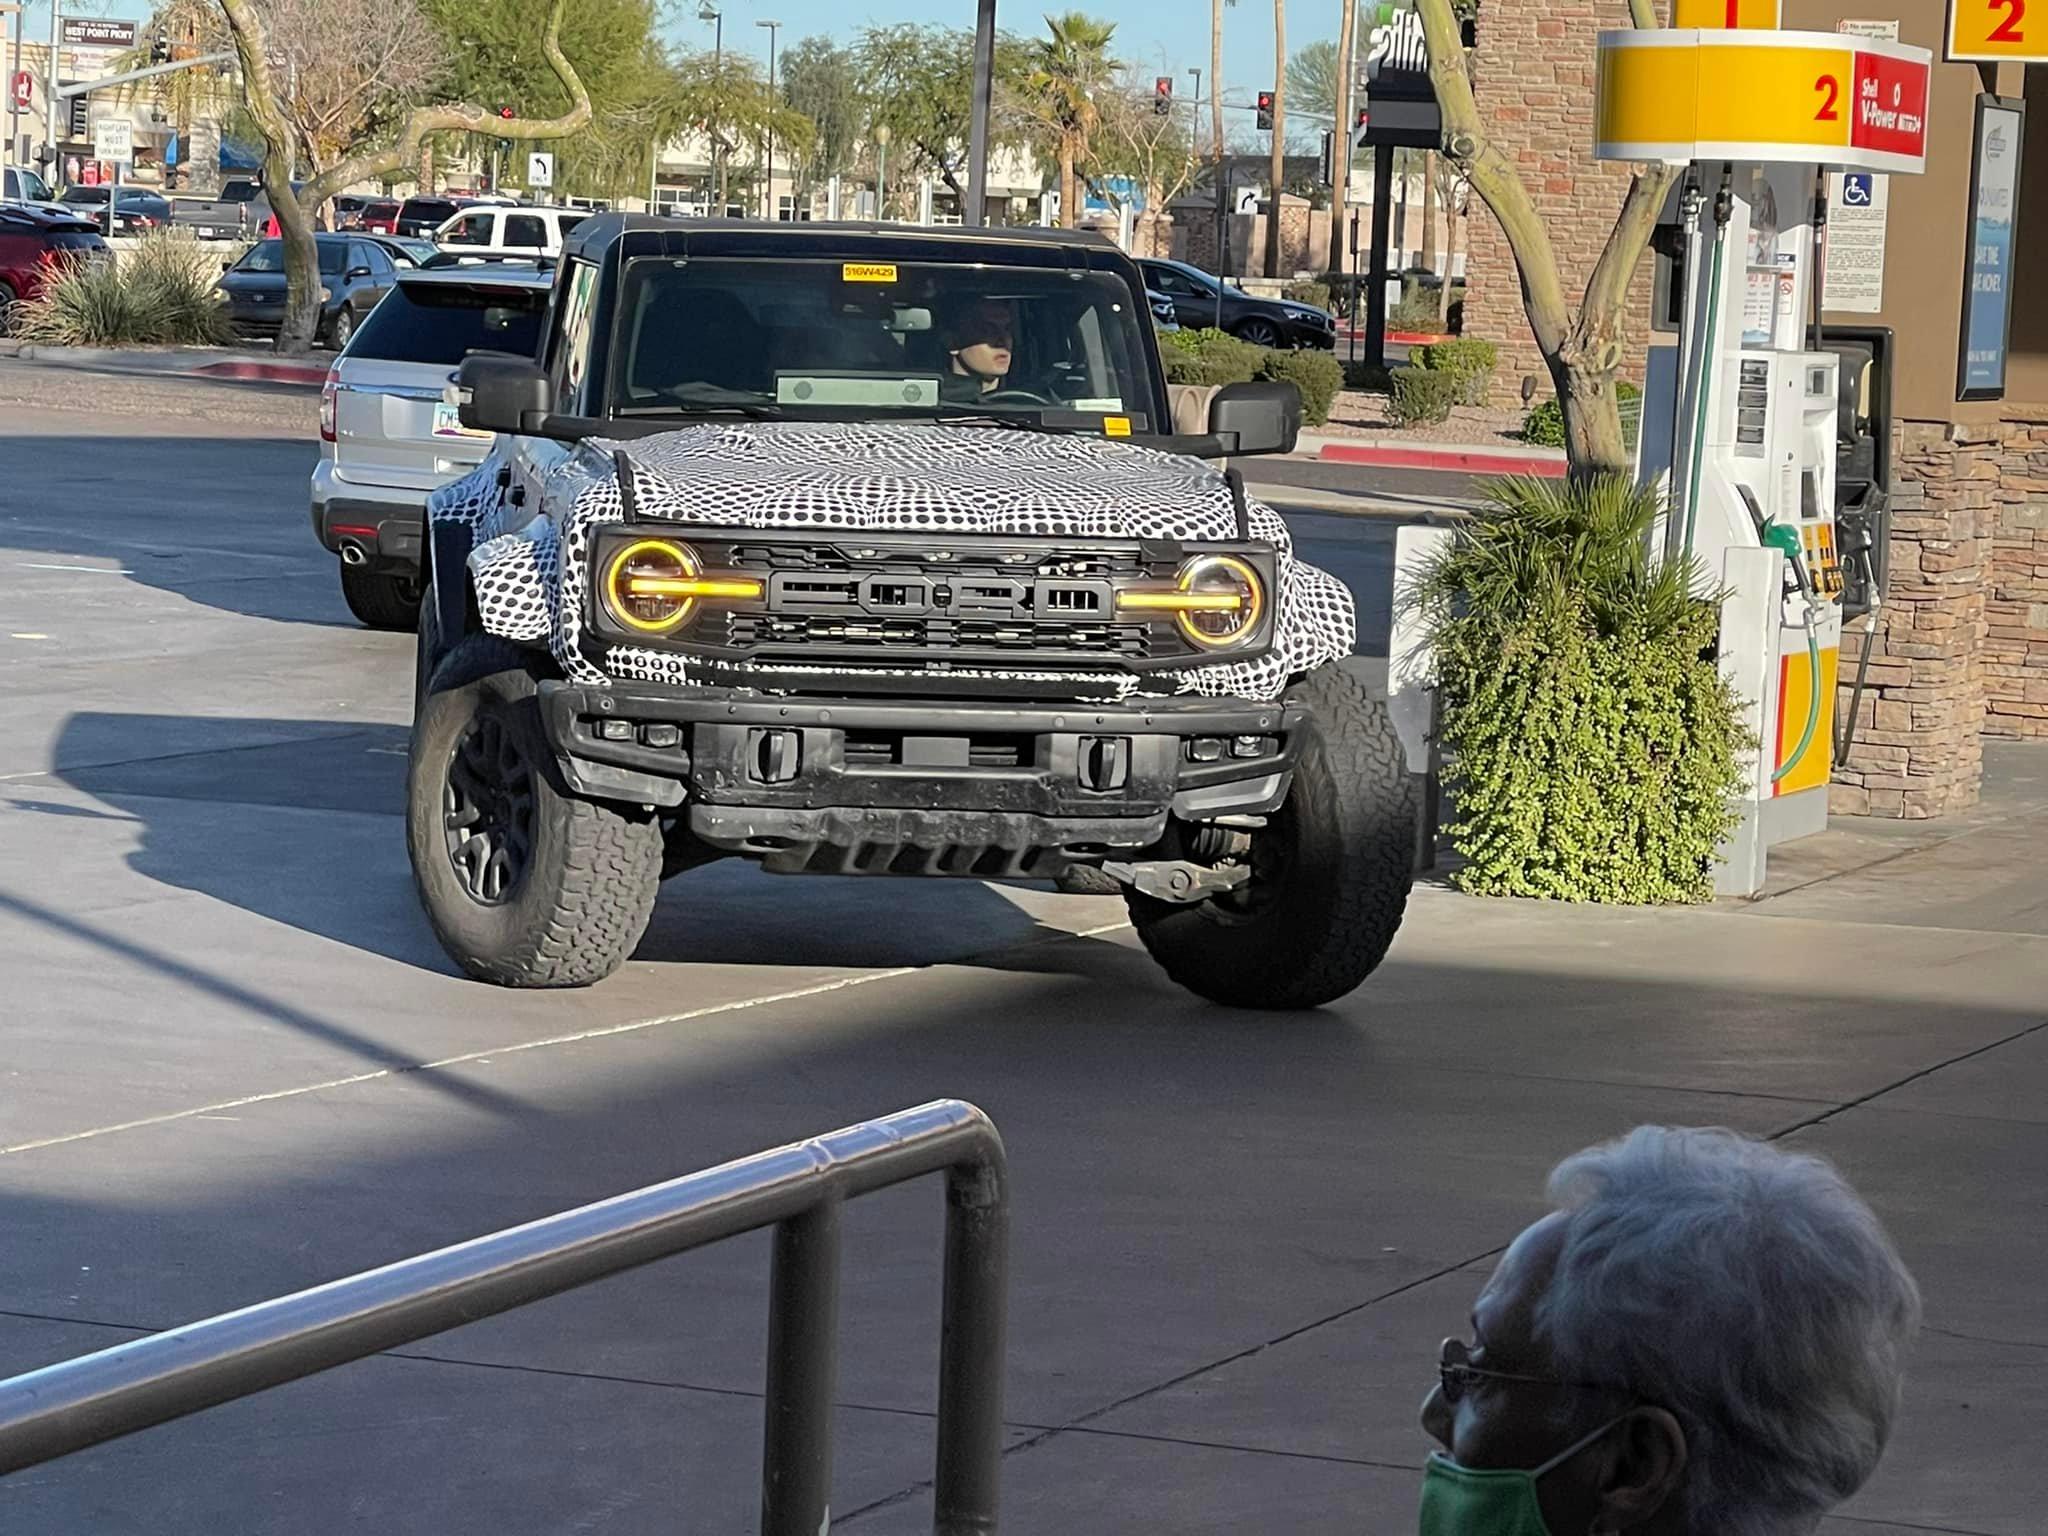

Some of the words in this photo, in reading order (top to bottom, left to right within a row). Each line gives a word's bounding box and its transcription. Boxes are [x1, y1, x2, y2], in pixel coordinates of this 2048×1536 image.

[65, 26, 86, 36] WEST
[87, 28, 109, 38] POINT
[1984, 0, 2025, 42] 2
[1814, 74, 1838, 121] 2
[1862, 77, 1879, 98] Shell
[1861, 99, 1897, 129] V-Power
[769, 569, 1113, 620] FORD
